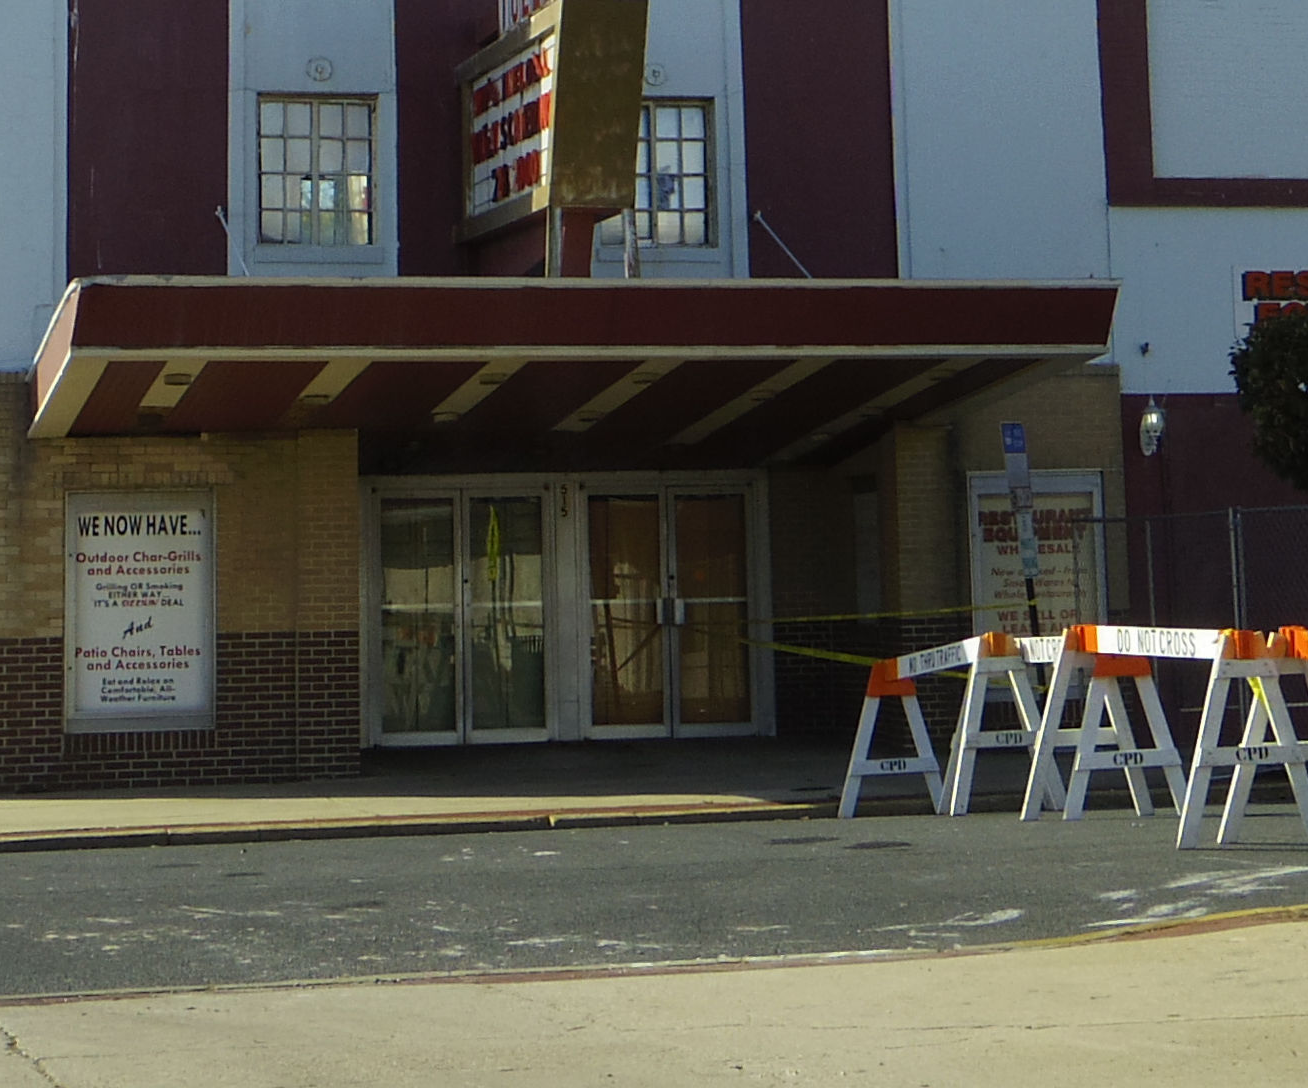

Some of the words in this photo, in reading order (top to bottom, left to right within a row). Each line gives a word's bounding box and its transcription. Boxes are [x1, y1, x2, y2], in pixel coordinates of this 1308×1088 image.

[78, 516, 99, 536] WE
[104, 515, 142, 536] NOW
[76, 552, 129, 563] Outdoor
[133, 550, 201, 562] Char-Grills
[87, 565, 112, 576] and
[116, 564, 190, 576] Accessories
[161, 599, 184, 607] DEAL
[1117, 628, 1131, 653] DO
[75, 647, 108, 658] Patio
[111, 646, 156, 659] Chairs,
[160, 645, 201, 657] Tables
[87, 660, 111, 671] and
[115, 658, 190, 670] Accessories
[996, 731, 1022, 744] CPD
[1112, 752, 1143, 768] CPD
[1235, 746, 1269, 762] CPD
[880, 759, 906, 772] CPD
